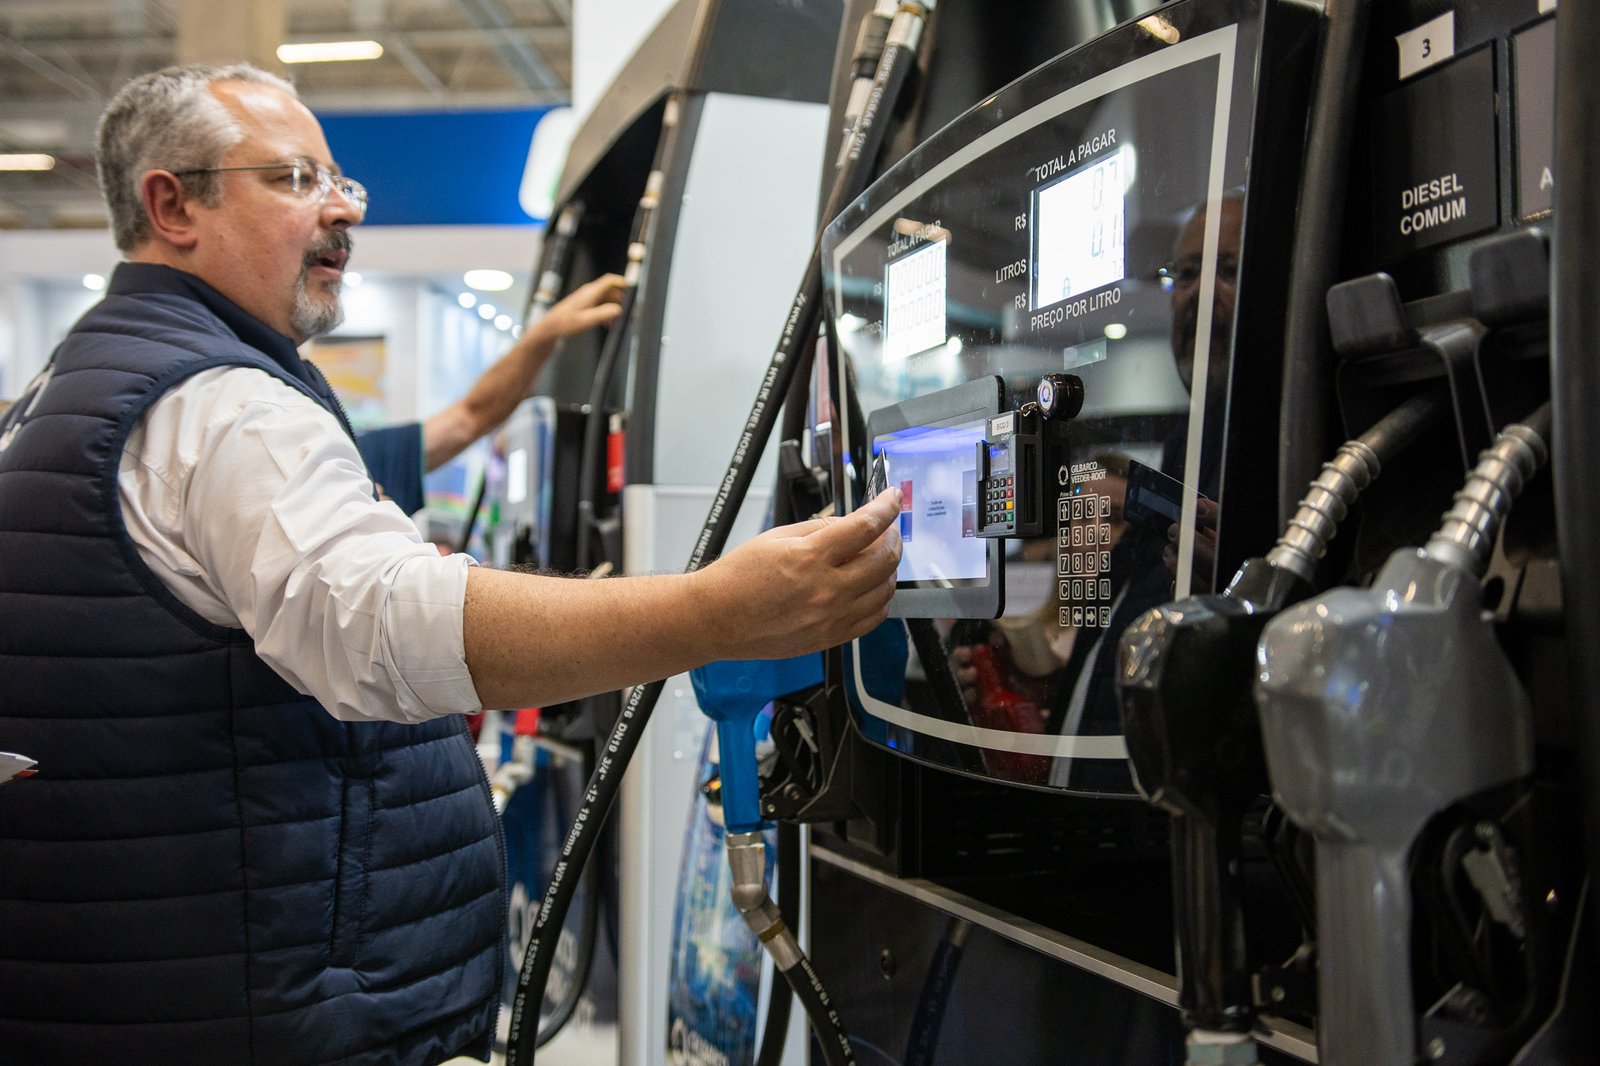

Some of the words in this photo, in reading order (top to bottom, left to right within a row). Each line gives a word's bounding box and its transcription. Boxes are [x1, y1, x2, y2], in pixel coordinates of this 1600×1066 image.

[1422, 38, 1431, 58] 3
[1034, 155, 1066, 182] TOTAL
[1068, 150, 1076, 166] A
[1078, 128, 1116, 161] PAGAR
[1402, 173, 1464, 210] DIESEL
[1014, 212, 1027, 232] R$
[1400, 197, 1466, 235] COMUM
[887, 238, 908, 258] TOTAL
[909, 233, 916, 247] A
[916, 220, 942, 244] PAGAR
[996, 258, 1027, 284] LITROS
[1014, 292, 1026, 310] R$
[1031, 307, 1064, 332] PREÇO
[1066, 298, 1088, 320] POR
[1089, 287, 1121, 312] LITRO
[785, 306, 801, 336] HYLIK
[758, 366, 778, 400] HYLIK
[746, 400, 765, 430] FUEL
[733, 432, 753, 464] HOSE
[1070, 462, 1098, 474] GILBARCO
[1070, 472, 1106, 484] VEEDER-ROOT
[708, 466, 738, 524] PORTARIA
[1074, 502, 1080, 516] 2
[1088, 501, 1094, 515] 3
[1101, 500, 1109, 514] P1
[1075, 530, 1080, 543] 5
[1088, 528, 1094, 542] 6
[1101, 527, 1109, 542] P2
[1062, 557, 1067, 570] 7
[1075, 556, 1080, 570] 8
[1088, 555, 1093, 569] 9
[1062, 583, 1068, 597] C
[1088, 582, 1094, 596] E
[608, 722, 628, 753] DN19
[596, 756, 612, 780] 3/4"
[585, 784, 598, 803] -12
[520, 938, 540, 986] 1520PSI
[510, 992, 526, 1041] 105BAR
